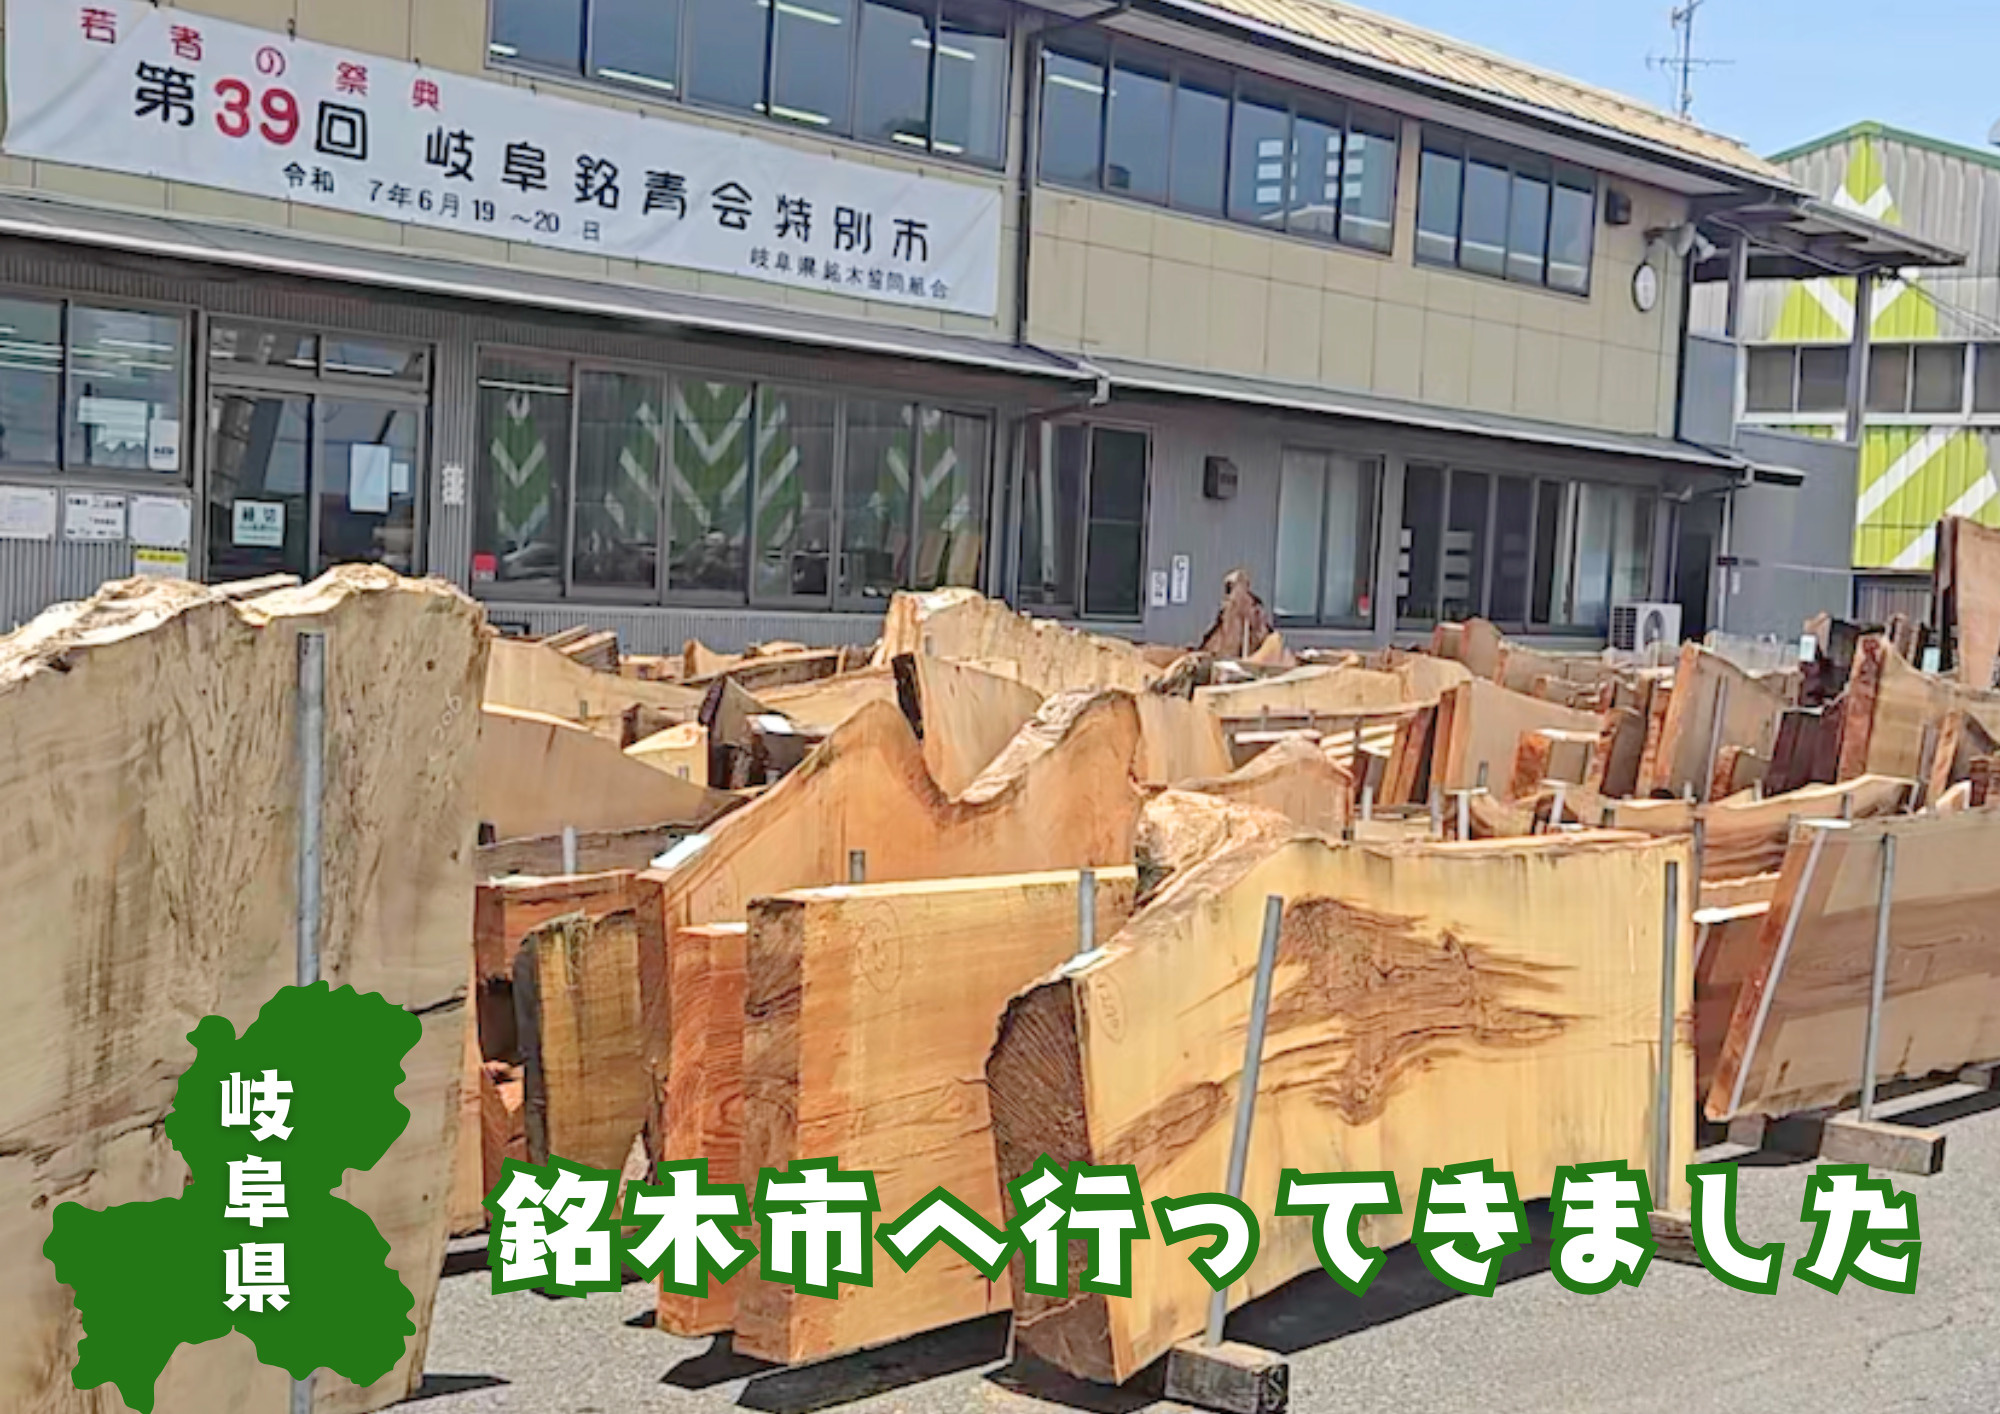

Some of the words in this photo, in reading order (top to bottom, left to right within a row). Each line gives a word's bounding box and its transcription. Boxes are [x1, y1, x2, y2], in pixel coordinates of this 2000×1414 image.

[80, 8, 441, 112] 若者の祭典
[134, 61, 368, 160] 第39回
[426, 126, 929, 263] 岐阜銘青会特別市
